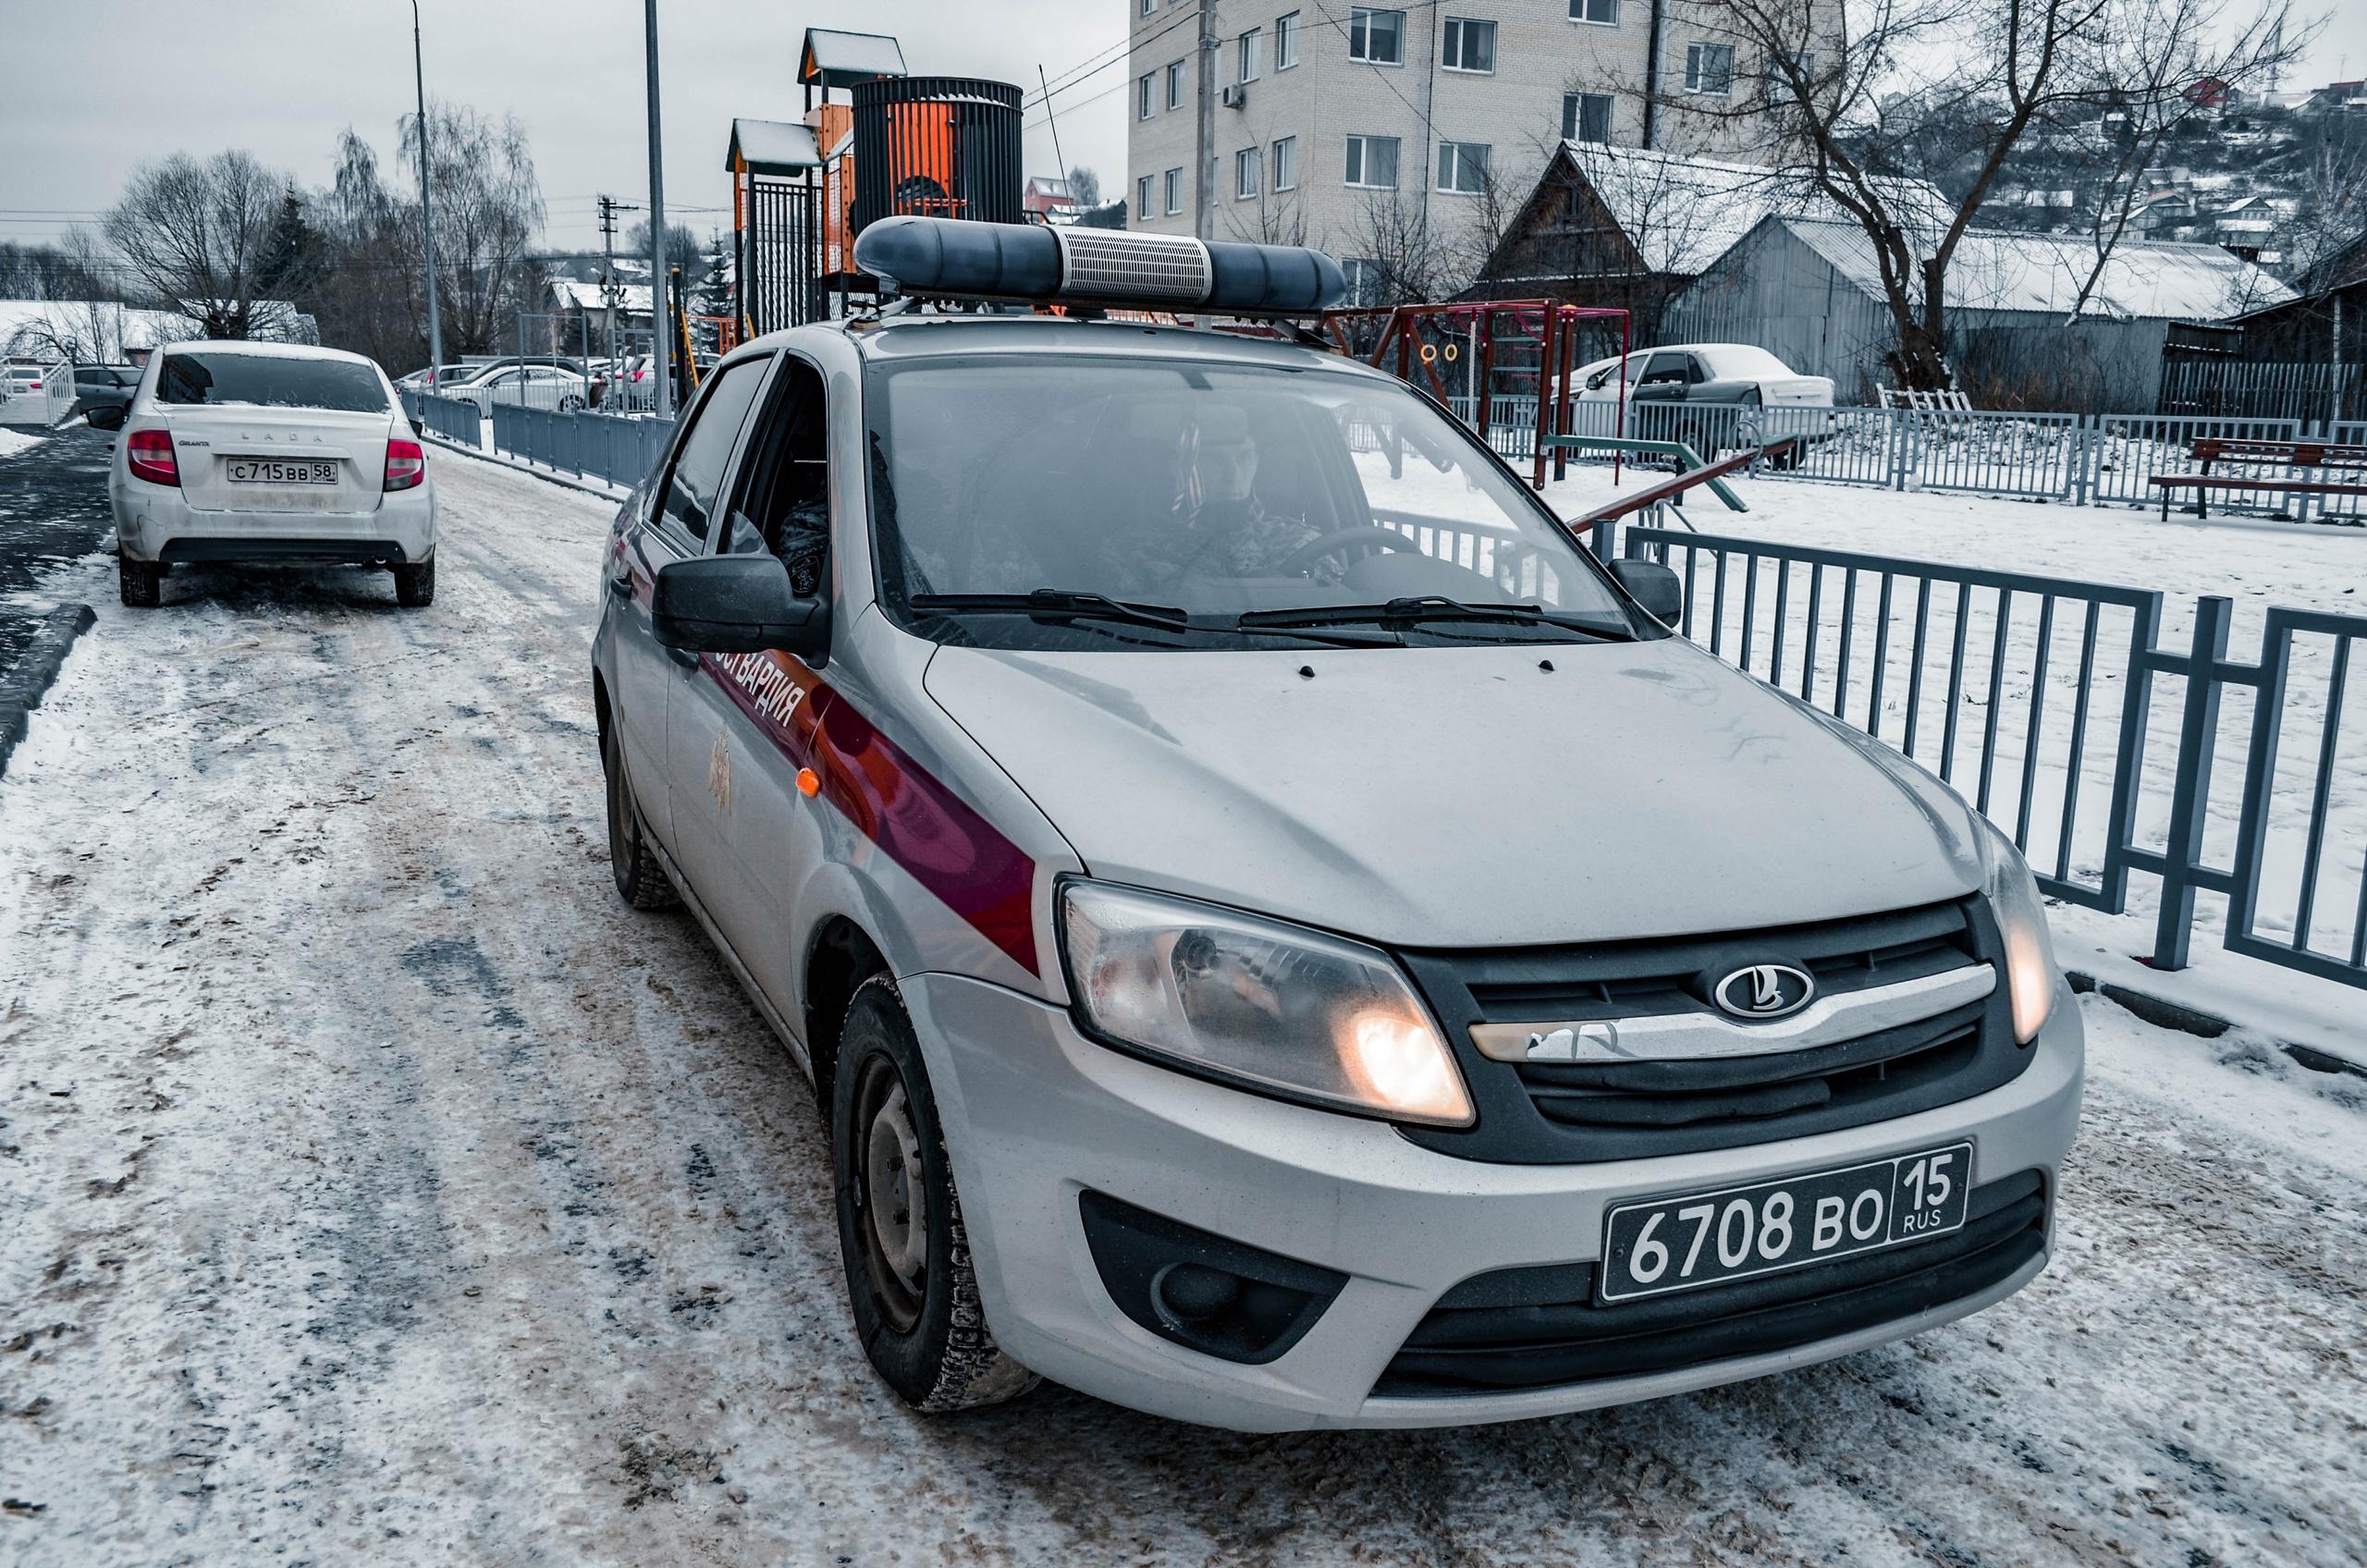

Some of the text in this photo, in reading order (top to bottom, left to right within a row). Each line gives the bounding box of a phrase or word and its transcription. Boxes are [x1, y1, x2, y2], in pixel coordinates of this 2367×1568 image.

[242, 432, 323, 443] LADA
[313, 465, 332, 477] 58
[1629, 1191, 1794, 1283] 6708
[1903, 1153, 1953, 1210] 15
[1904, 1210, 1942, 1233] RUS
